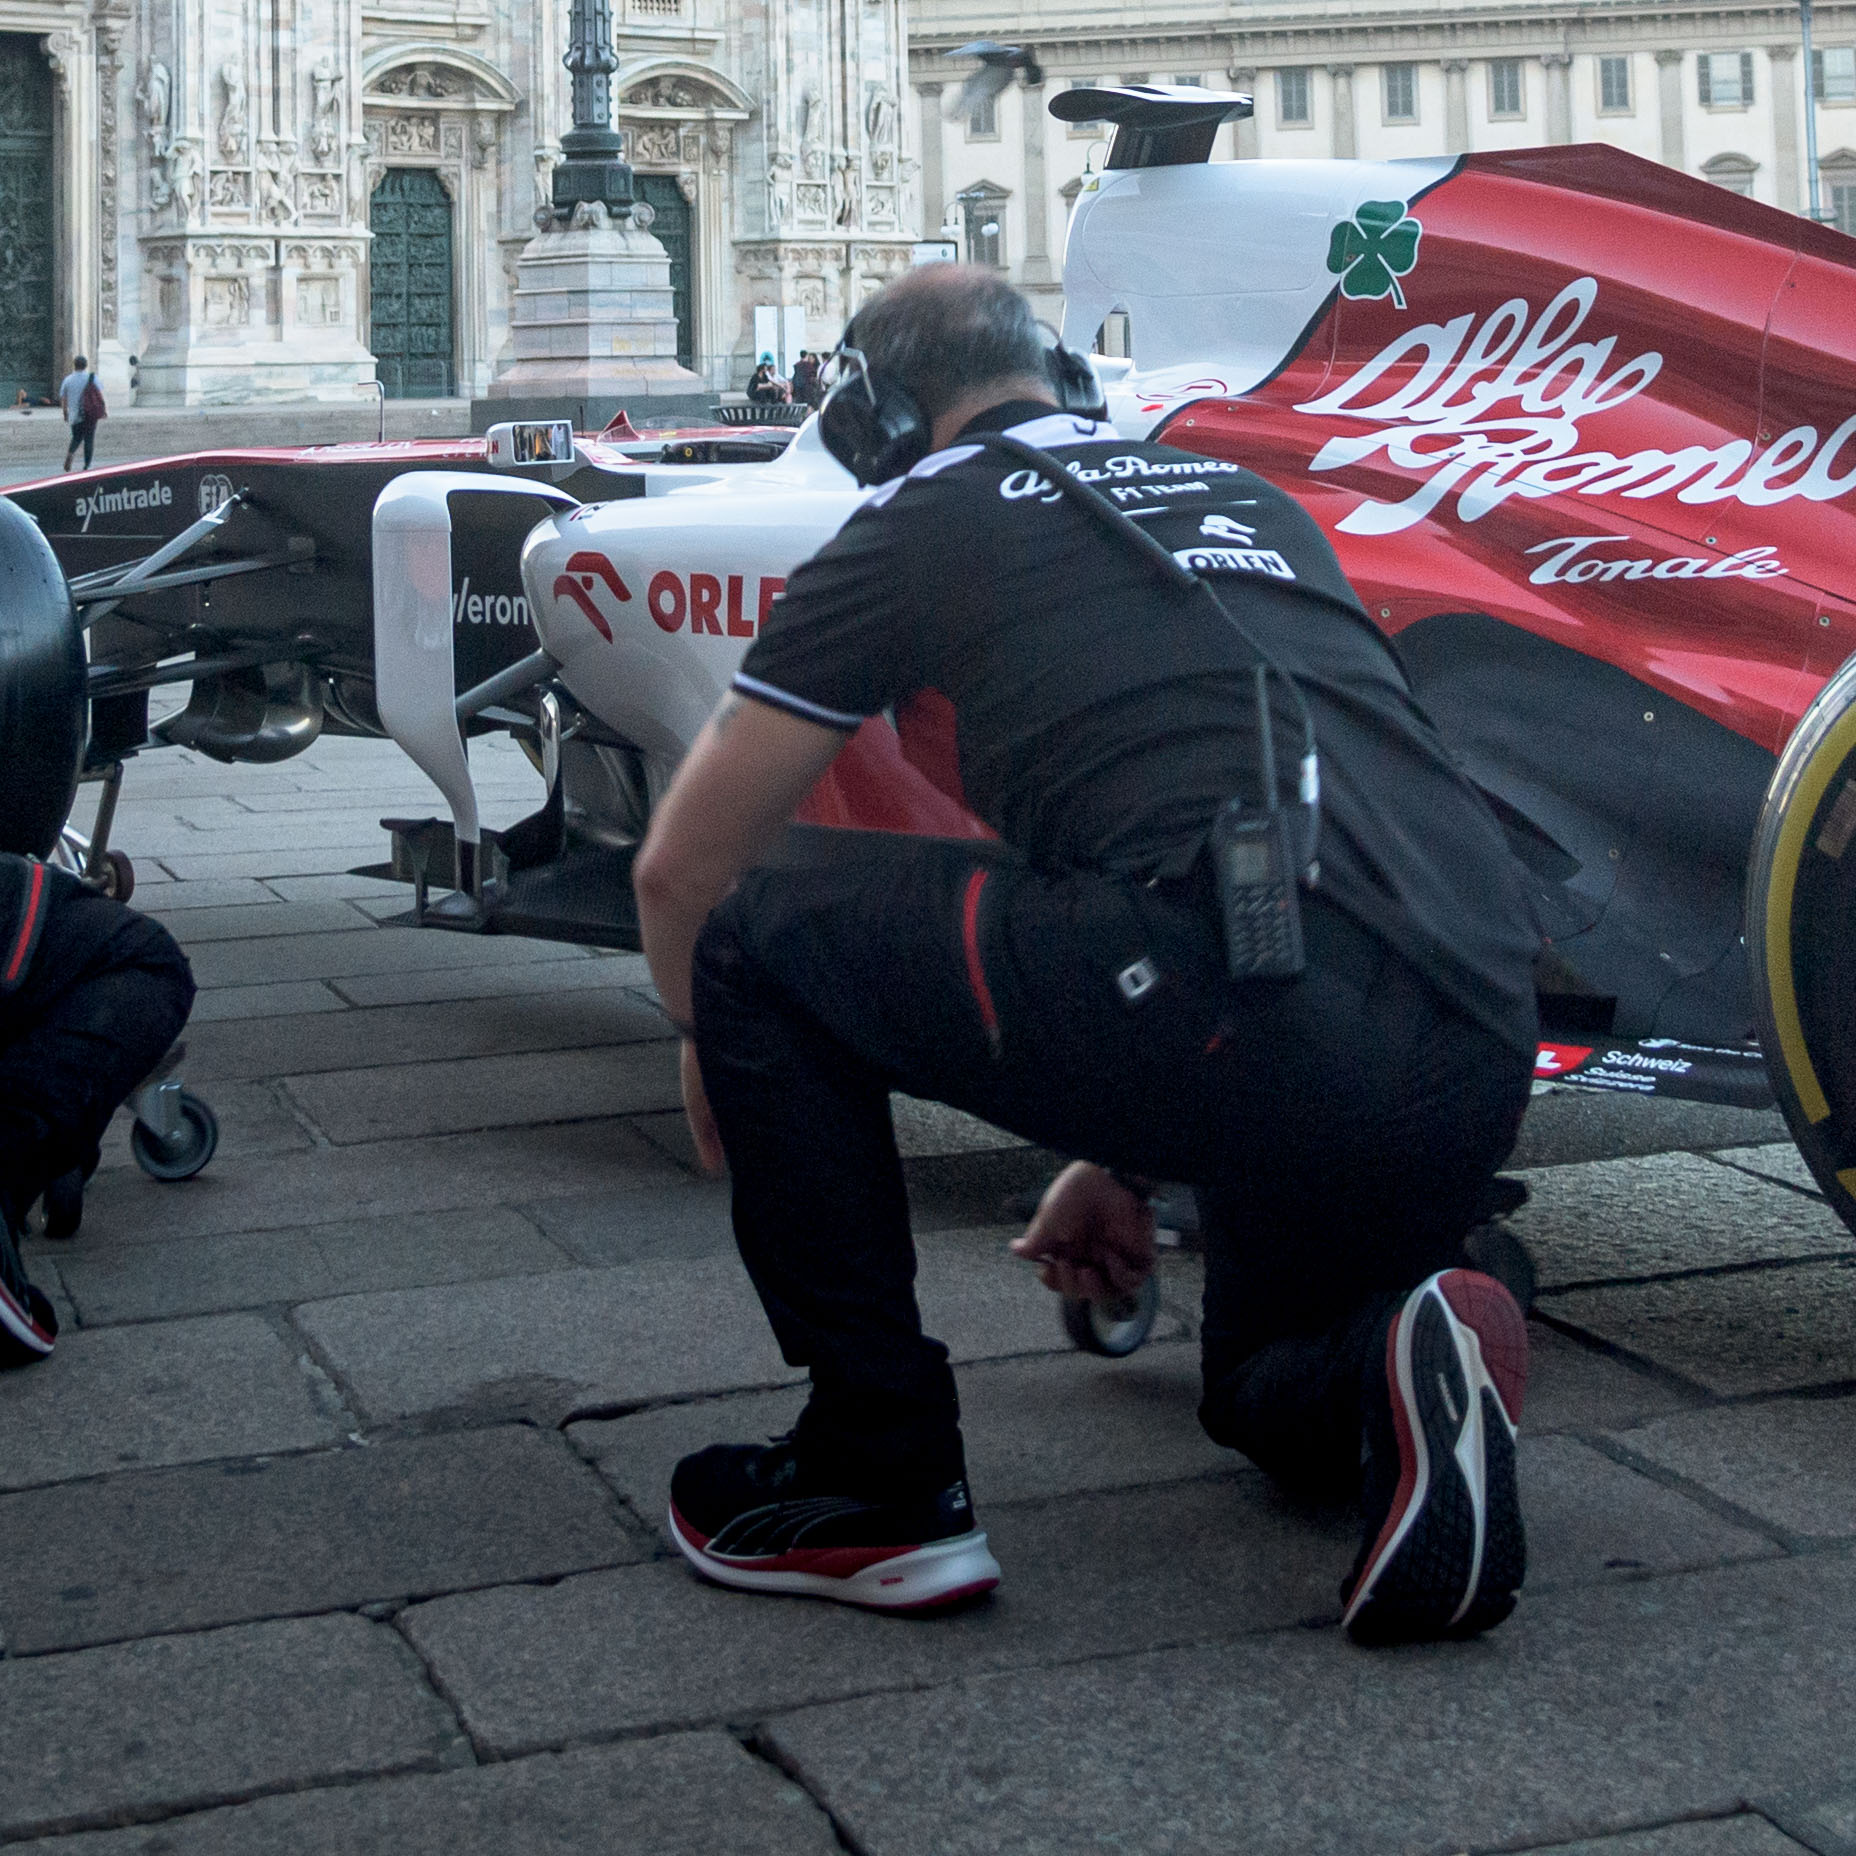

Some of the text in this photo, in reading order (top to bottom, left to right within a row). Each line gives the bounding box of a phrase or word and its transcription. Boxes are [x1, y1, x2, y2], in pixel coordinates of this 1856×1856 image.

[1292, 276, 1664, 425] Alfa
[75, 480, 173, 533] aximtrade
[200, 484, 231, 514] FIA
[1524, 535, 1790, 584] Tonale
[648, 570, 787, 638] ORLE
[1601, 1049, 1693, 1074] Schweiz
